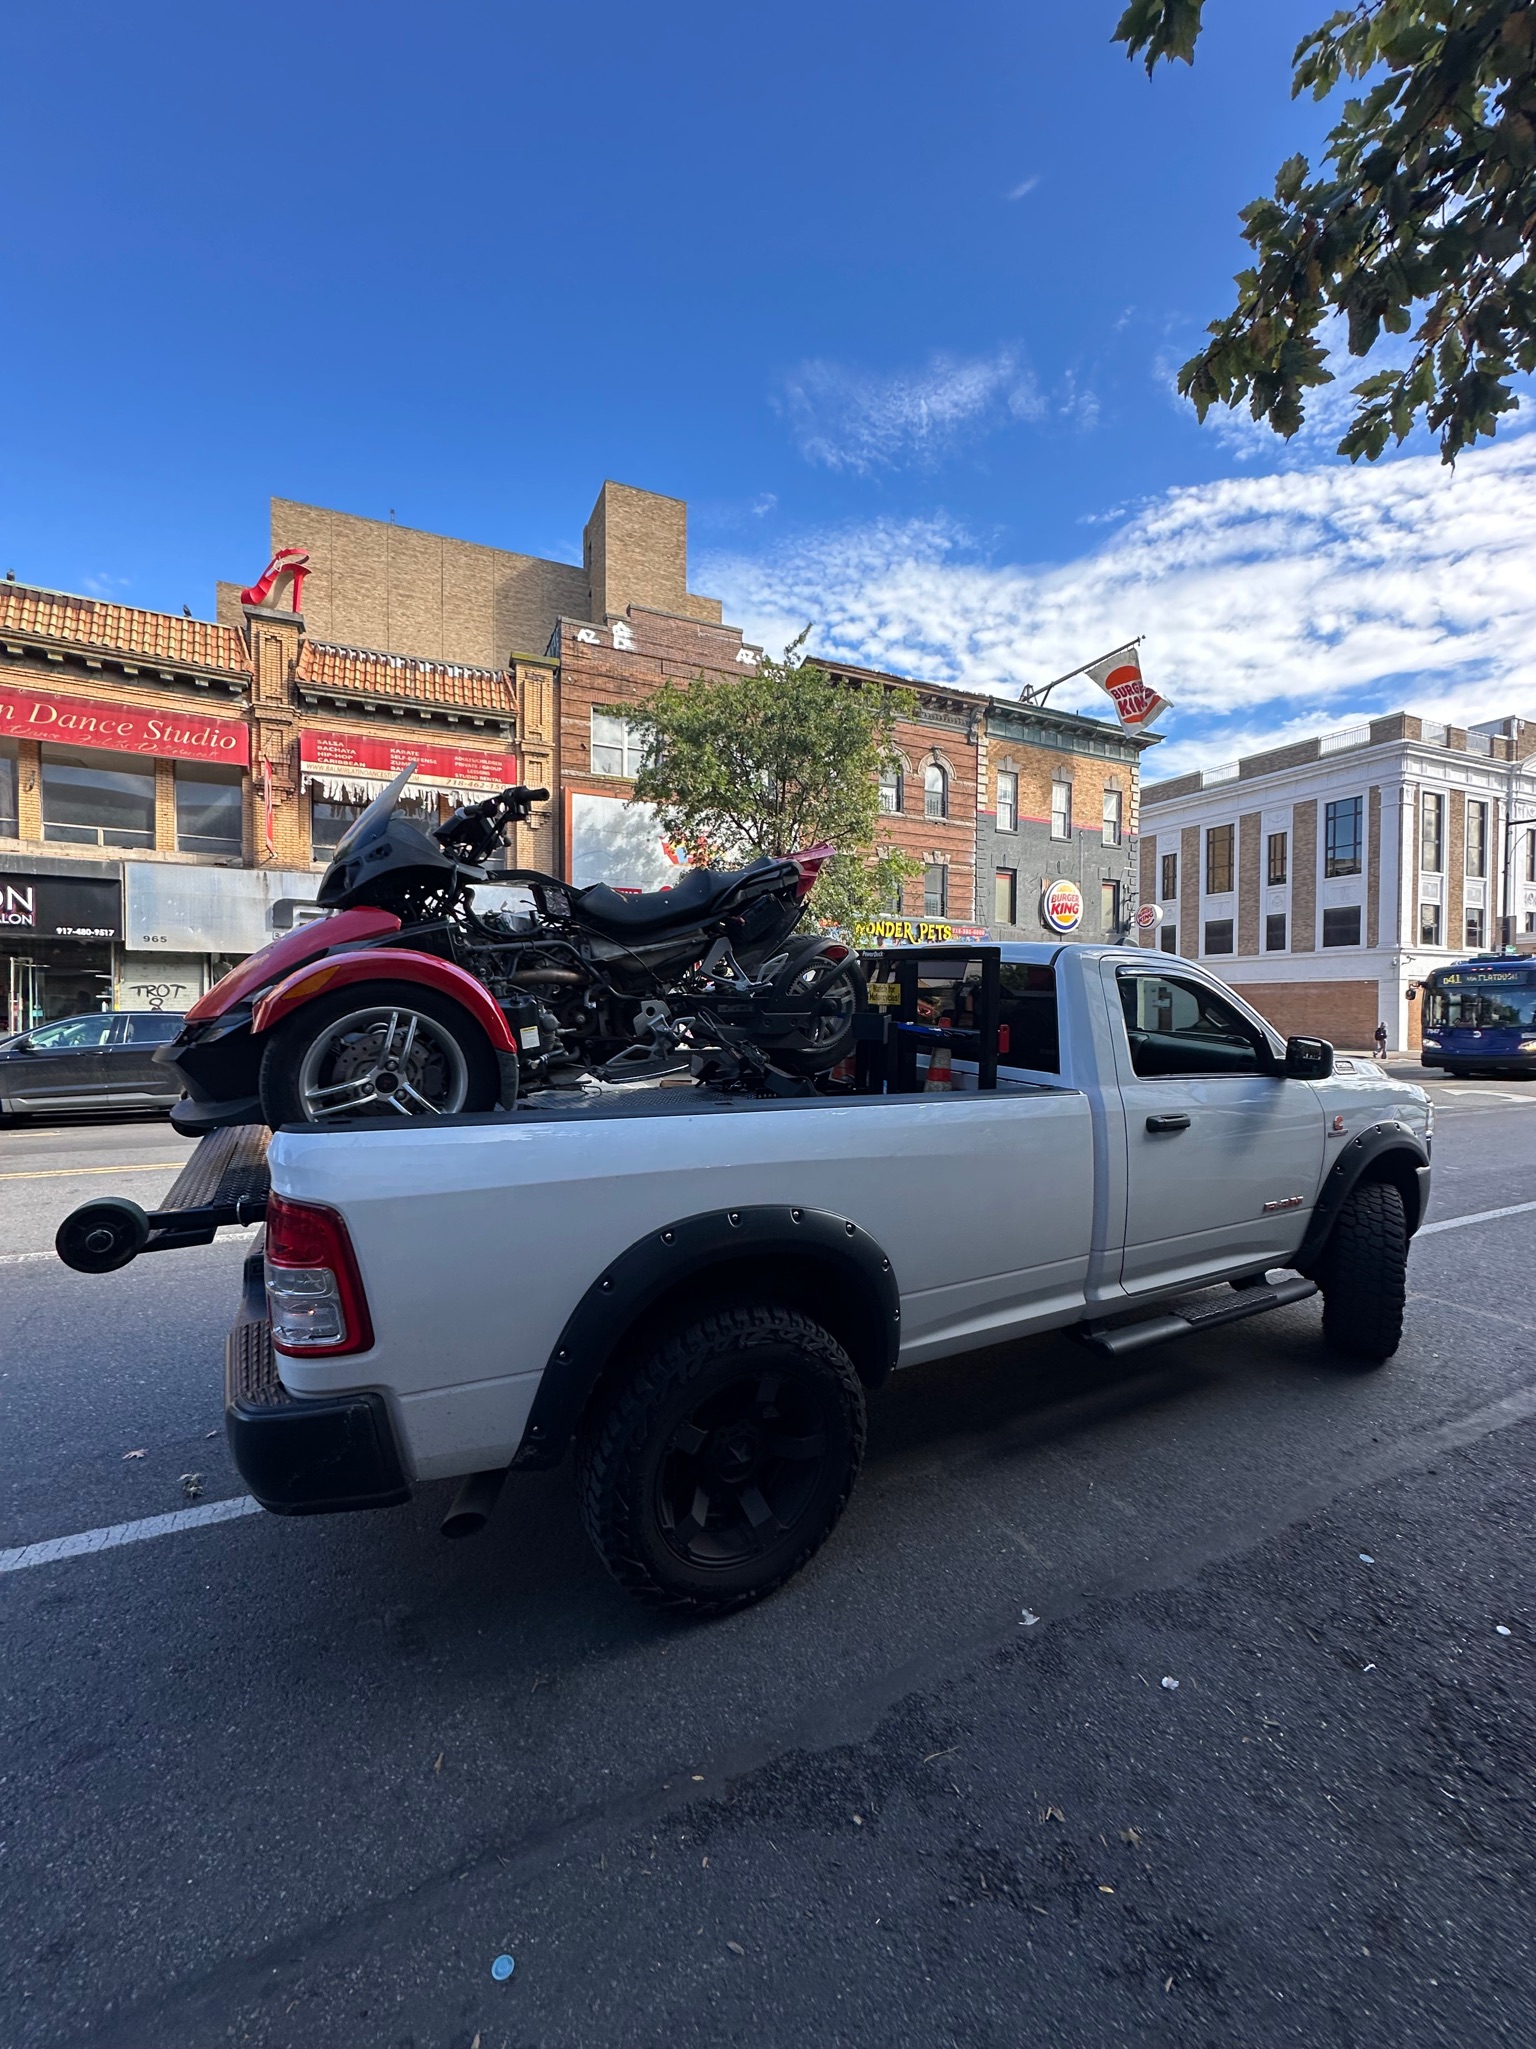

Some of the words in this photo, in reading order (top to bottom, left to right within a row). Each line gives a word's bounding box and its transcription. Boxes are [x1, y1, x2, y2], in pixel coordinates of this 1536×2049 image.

[1111, 681, 1144, 700] BURGE
[1118, 696, 1147, 717] KIN
[25, 702, 133, 736] Dance
[143, 720, 236, 749] Studio
[317, 746, 356, 754] BACHATA
[317, 751, 353, 760] HIP-HOP
[390, 748, 419, 756] KARATE
[317, 757, 366, 767] CARIBBEAN
[446, 779, 508, 790] 718-462-150
[0, 885, 33, 911] N
[1051, 893, 1079, 903] BURGER
[1051, 902, 1079, 915] KING
[0, 913, 33, 926] LON
[920, 922, 952, 940] PETS
[143, 935, 168, 943] 965
[128, 984, 187, 998] TROT
